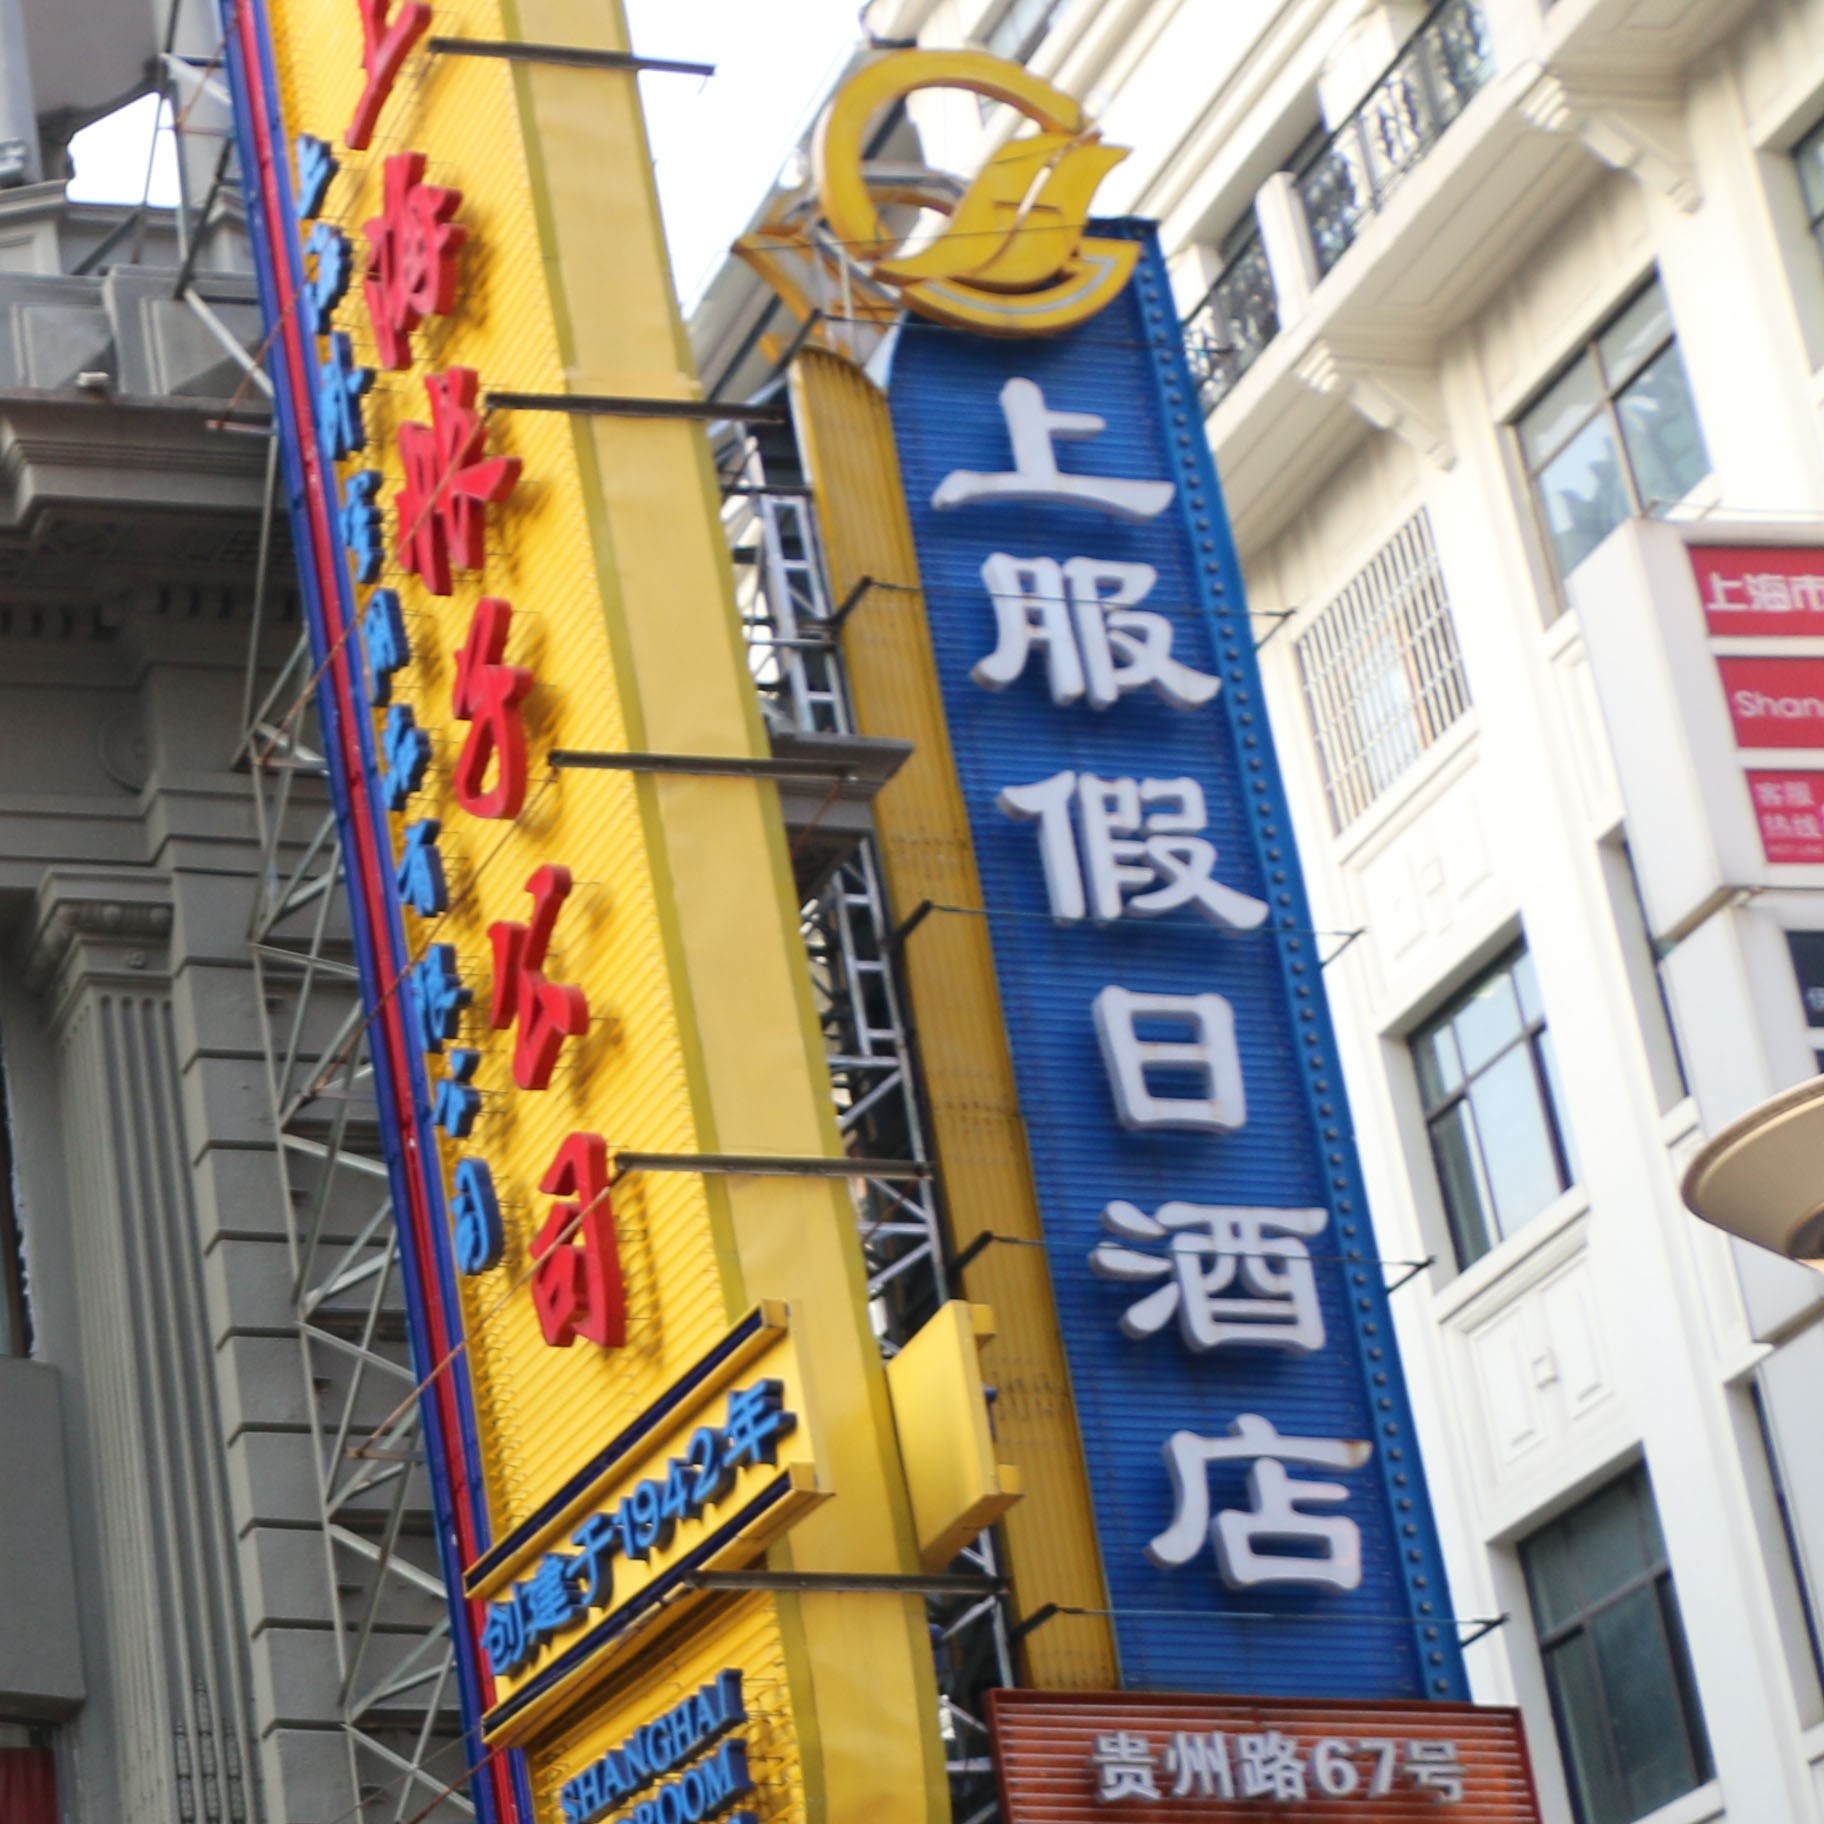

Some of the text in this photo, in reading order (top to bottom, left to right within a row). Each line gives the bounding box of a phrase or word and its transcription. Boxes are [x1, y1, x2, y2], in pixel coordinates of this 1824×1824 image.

[930, 376, 1374, 1592] 上服假日酒店
[478, 1378, 799, 1676] 创建于1942年
[1088, 1730, 1467, 1806] 贵州路67号
